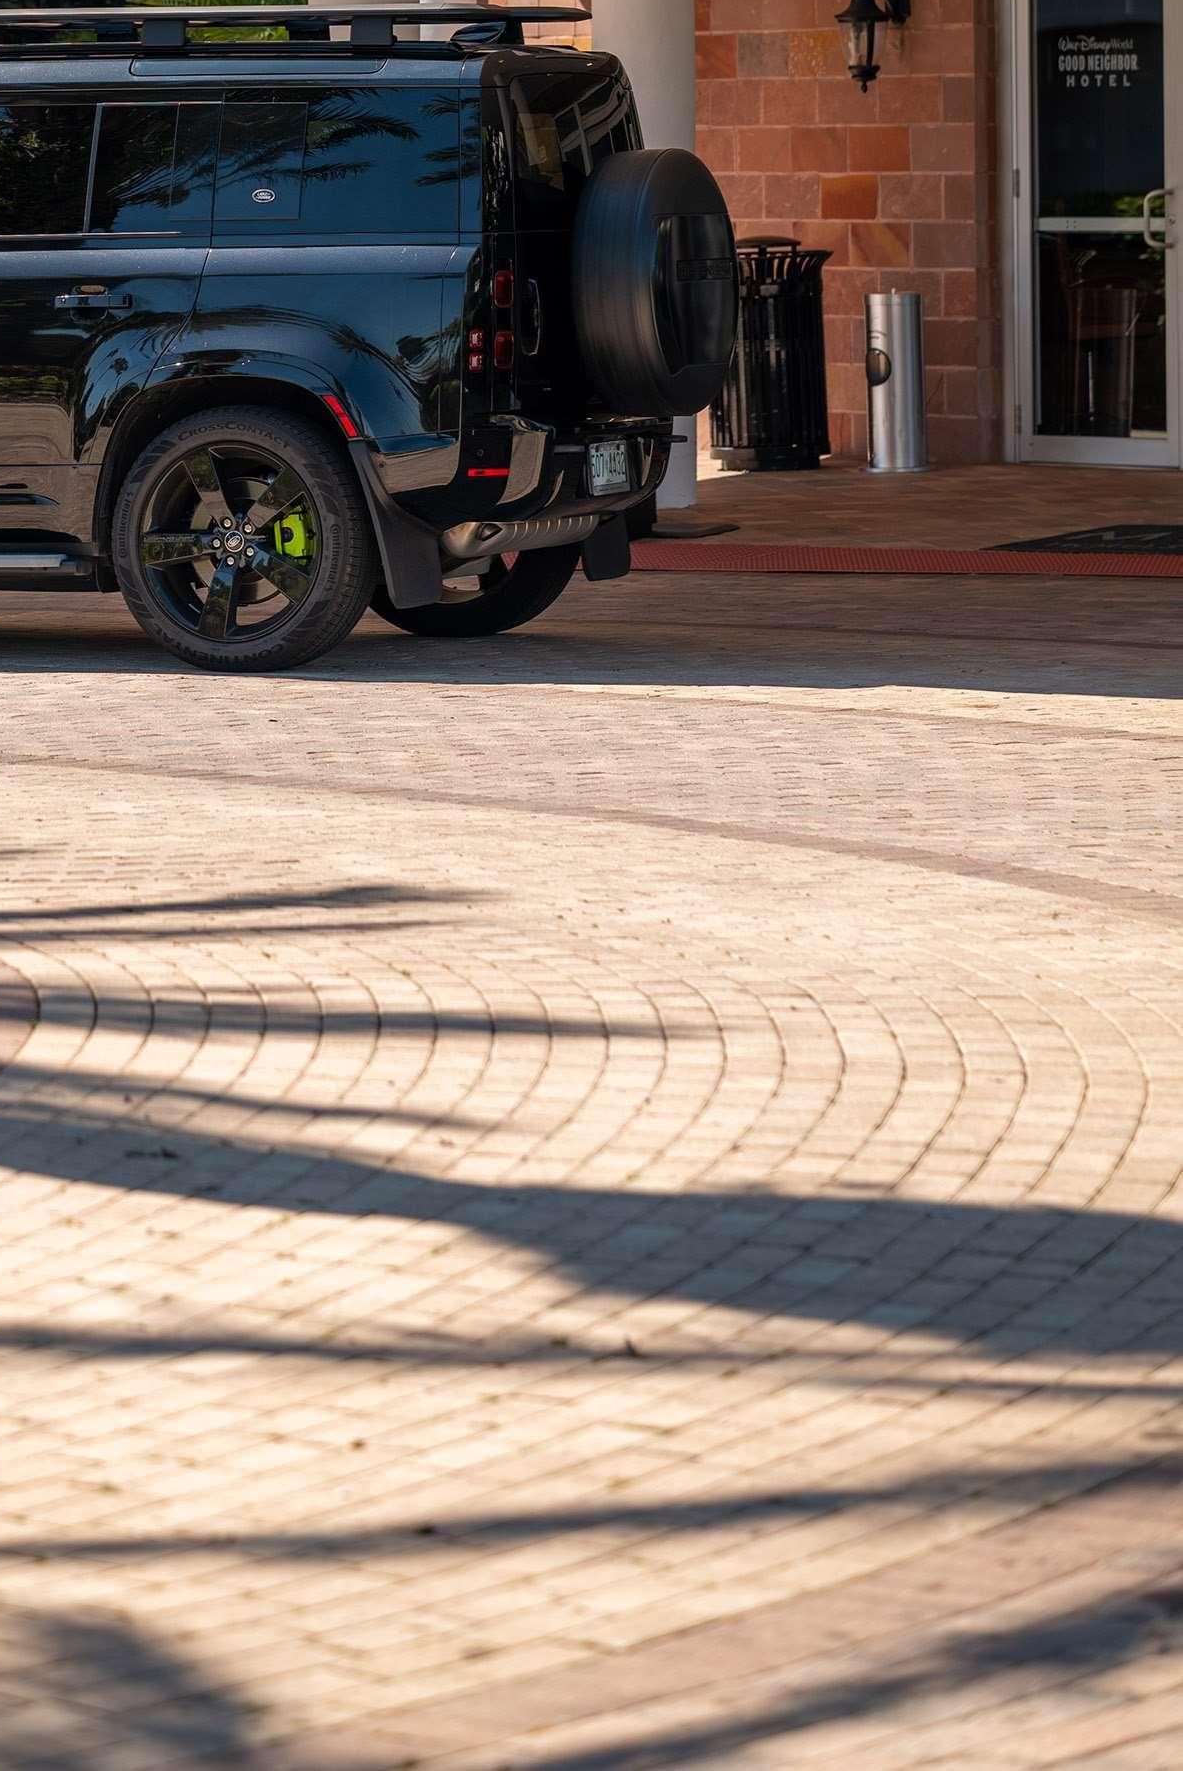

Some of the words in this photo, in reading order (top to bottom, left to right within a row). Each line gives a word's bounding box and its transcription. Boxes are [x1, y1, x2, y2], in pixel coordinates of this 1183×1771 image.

[1058, 54, 1086, 71] GOOD
[1087, 53, 1138, 71] NEIGHBOR
[1066, 73, 1131, 87] HOTEL
